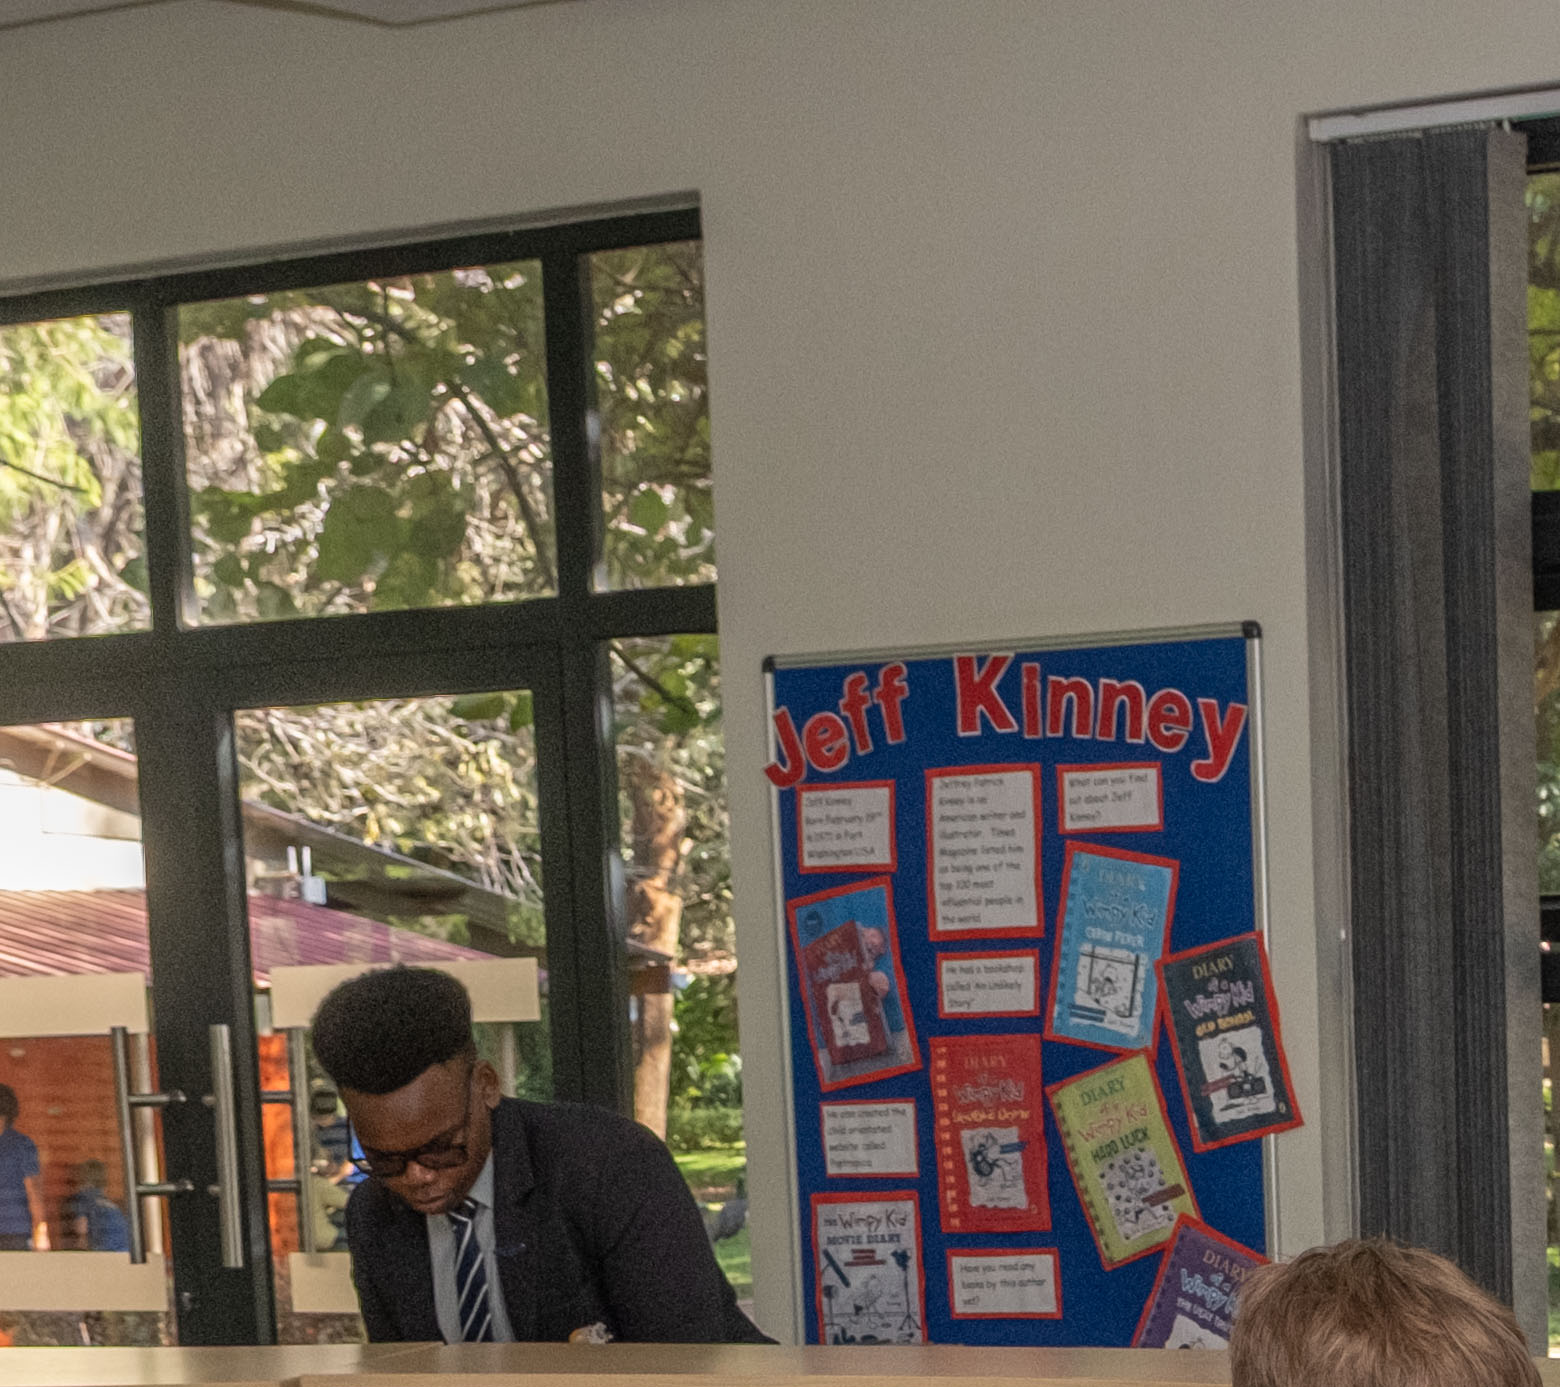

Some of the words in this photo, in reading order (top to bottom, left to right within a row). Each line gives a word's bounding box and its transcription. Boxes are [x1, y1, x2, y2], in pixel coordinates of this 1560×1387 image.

[762, 661, 909, 789] Jeff
[953, 653, 1248, 783] Kinney
[1192, 955, 1233, 980] DIARY
[1080, 1076, 1125, 1106] DIARY
